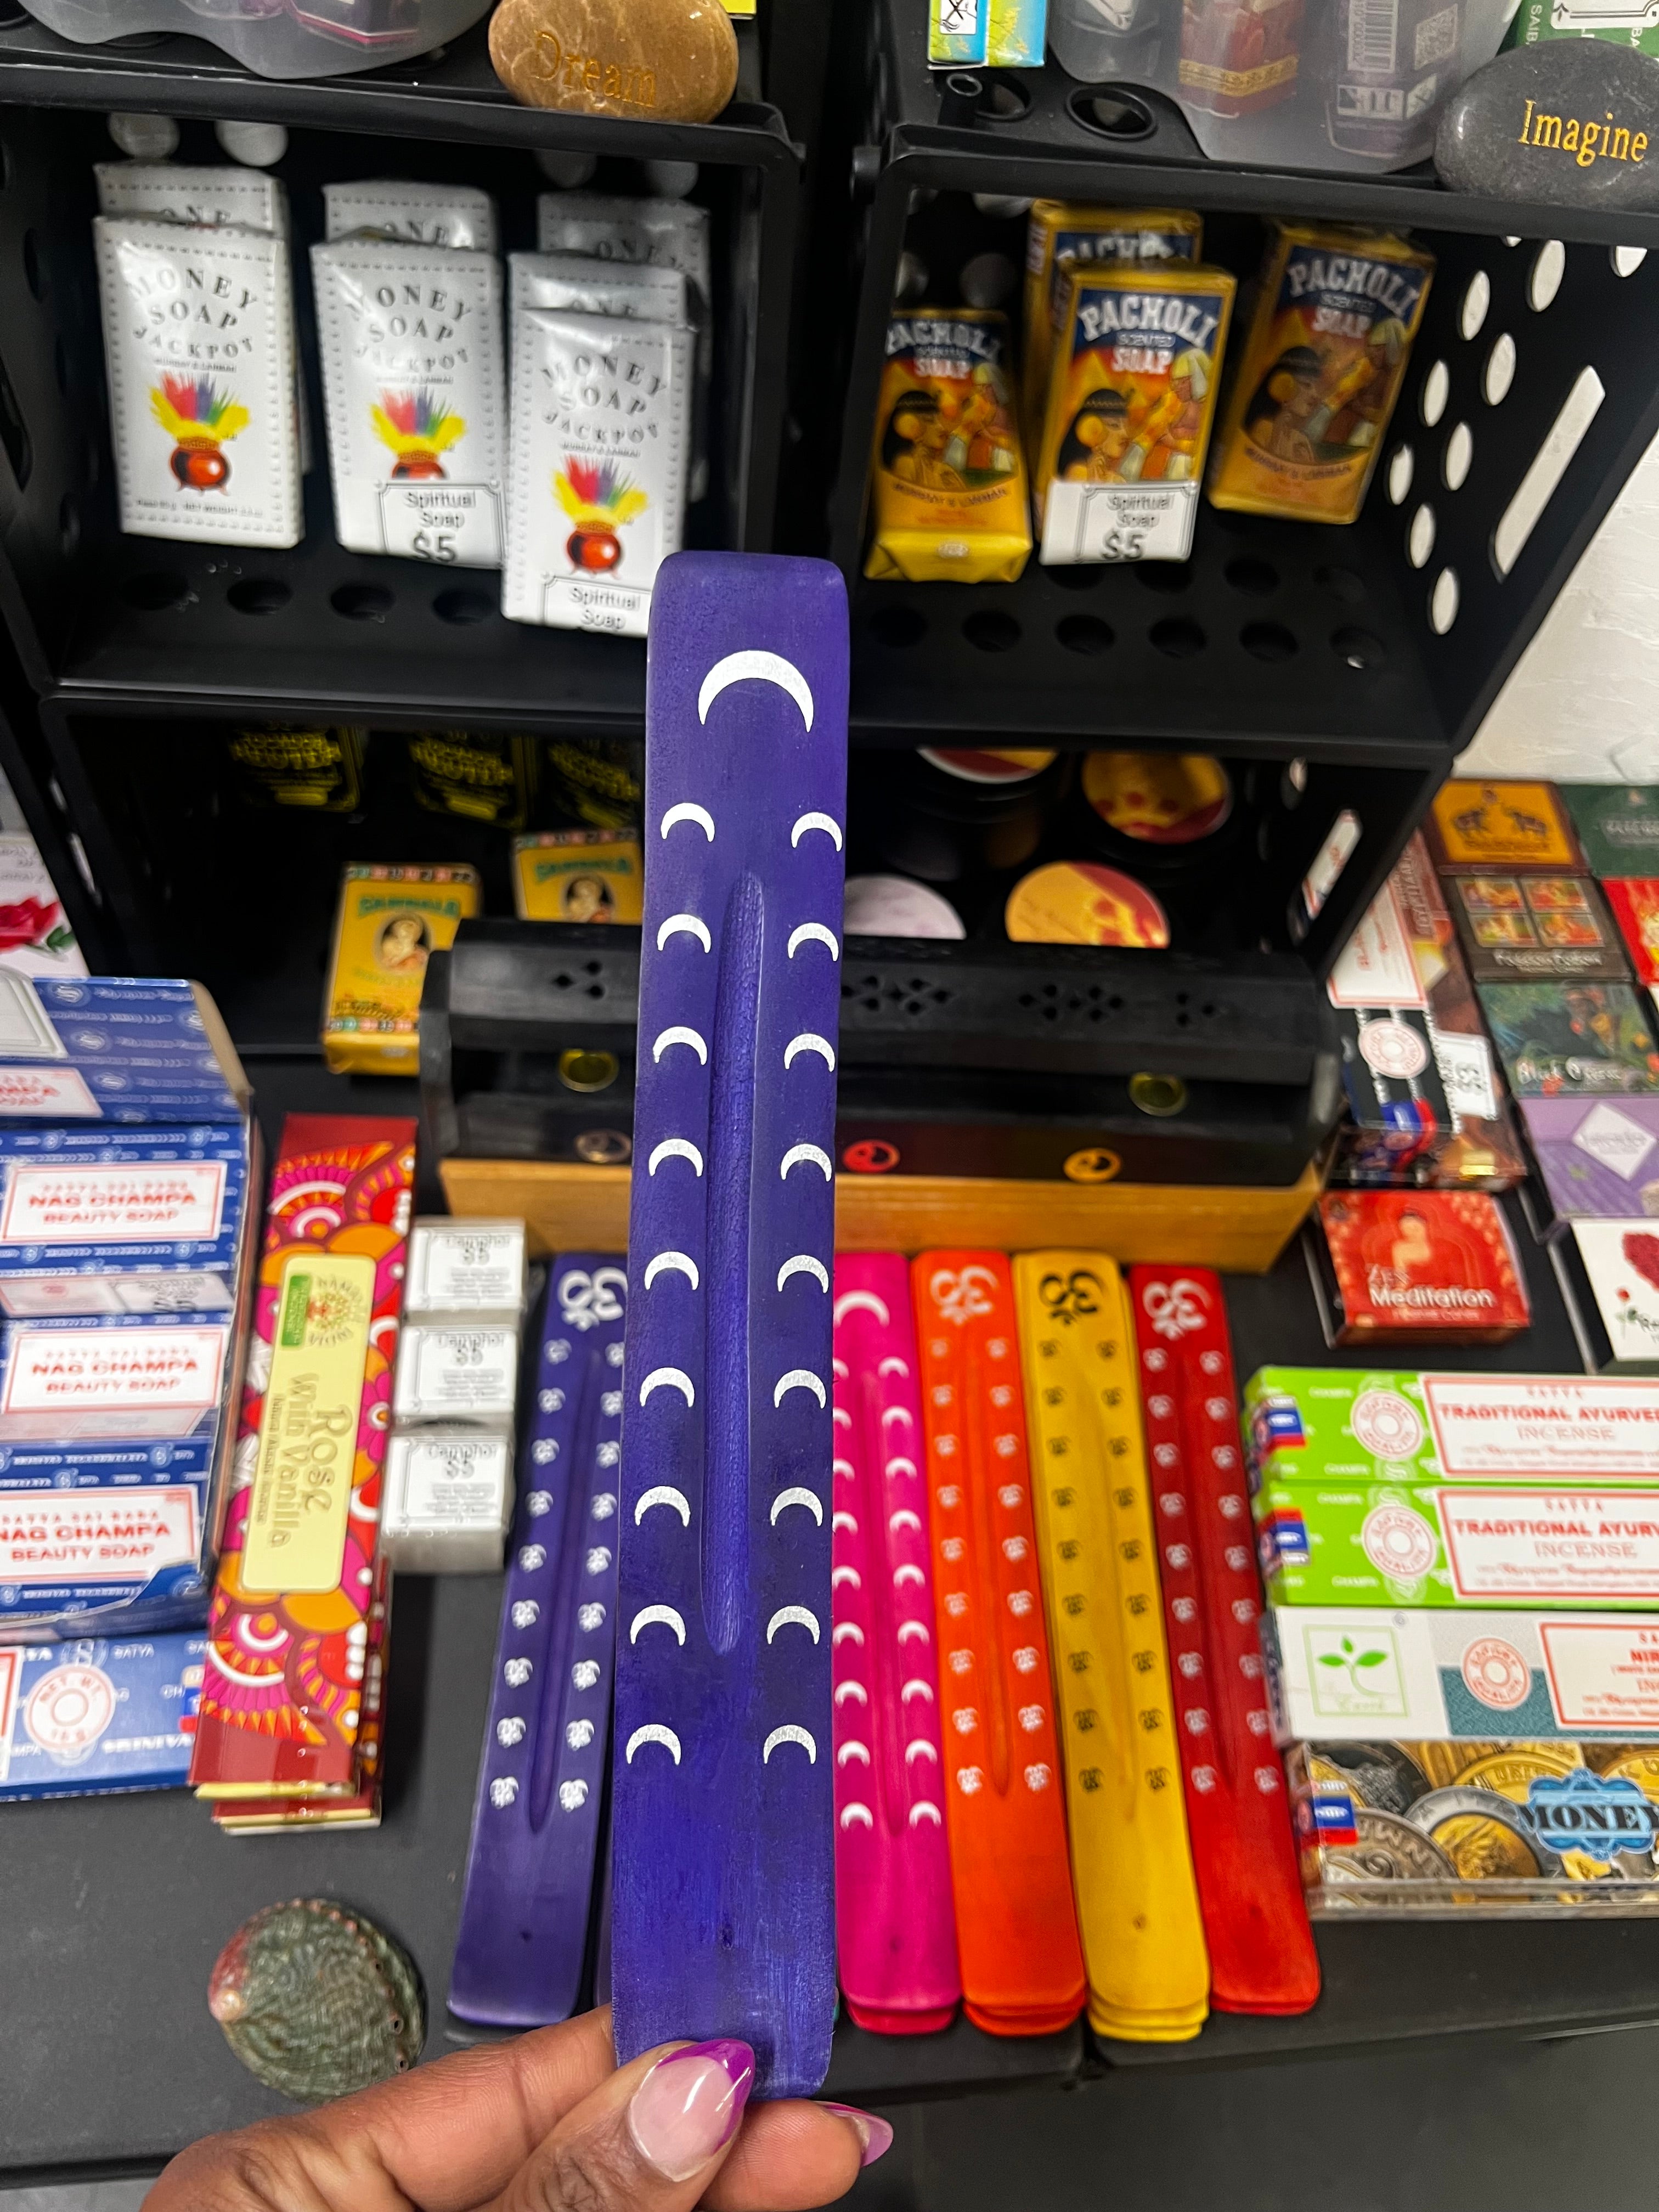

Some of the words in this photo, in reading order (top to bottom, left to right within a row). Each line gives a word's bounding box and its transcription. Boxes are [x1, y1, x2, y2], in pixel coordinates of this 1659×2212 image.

[530, 30, 657, 108] Dream
[1517, 98, 1649, 167] Imagine
[150, 301, 239, 330] SOAP
[369, 317, 454, 343] SOAP
[1077, 294, 1218, 349] PACHOLI
[133, 326, 253, 359] JACKPOT
[540, 355, 667, 398] MONEY
[558, 386, 647, 416] SOAP
[542, 411, 659, 445] JACKPOT
[410, 530, 458, 563] $5
[1101, 529, 1147, 560] $5
[1369, 1284, 1497, 1308] Meditation
[1438, 1403, 1572, 1422] TRADITIONAL
[1516, 1425, 1617, 1441] INCENSE
[301, 1404, 353, 1516] Rose
[56, 1522, 171, 1541] CHAMPA
[1453, 1519, 1593, 1537] TRADITIONAL
[11, 1545, 93, 1562] BEAUTY
[99, 1543, 156, 1560] SOAP
[1533, 1541, 1638, 1559] INCENSE
